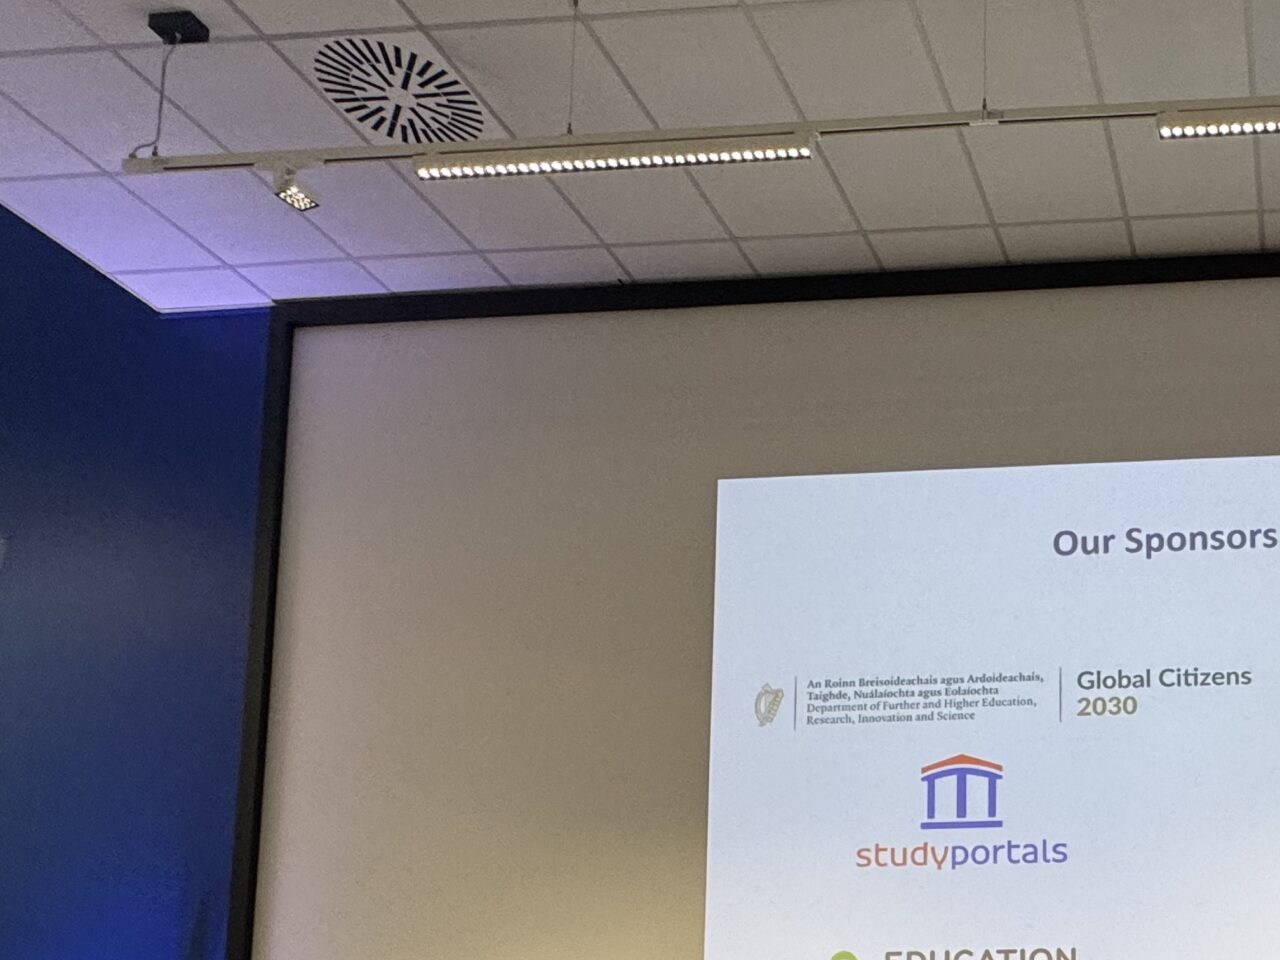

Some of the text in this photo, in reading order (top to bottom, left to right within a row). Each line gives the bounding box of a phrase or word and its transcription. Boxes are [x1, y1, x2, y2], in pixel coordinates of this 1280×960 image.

[1053, 527, 1278, 560] Our Sponsors
[807, 672, 1044, 689] An Roinn Breisoideachais agus Ardoideachais,
[1077, 667, 1253, 690] Global Citizens
[807, 685, 999, 702] Taighde, Nuálaíochta agus Eolaíochta
[807, 696, 1037, 714] Department of Further and Higher Education,
[1077, 696, 1138, 716] 2030
[806, 710, 975, 725] Research, Innovation and Science
[856, 839, 1068, 870] studyportals
